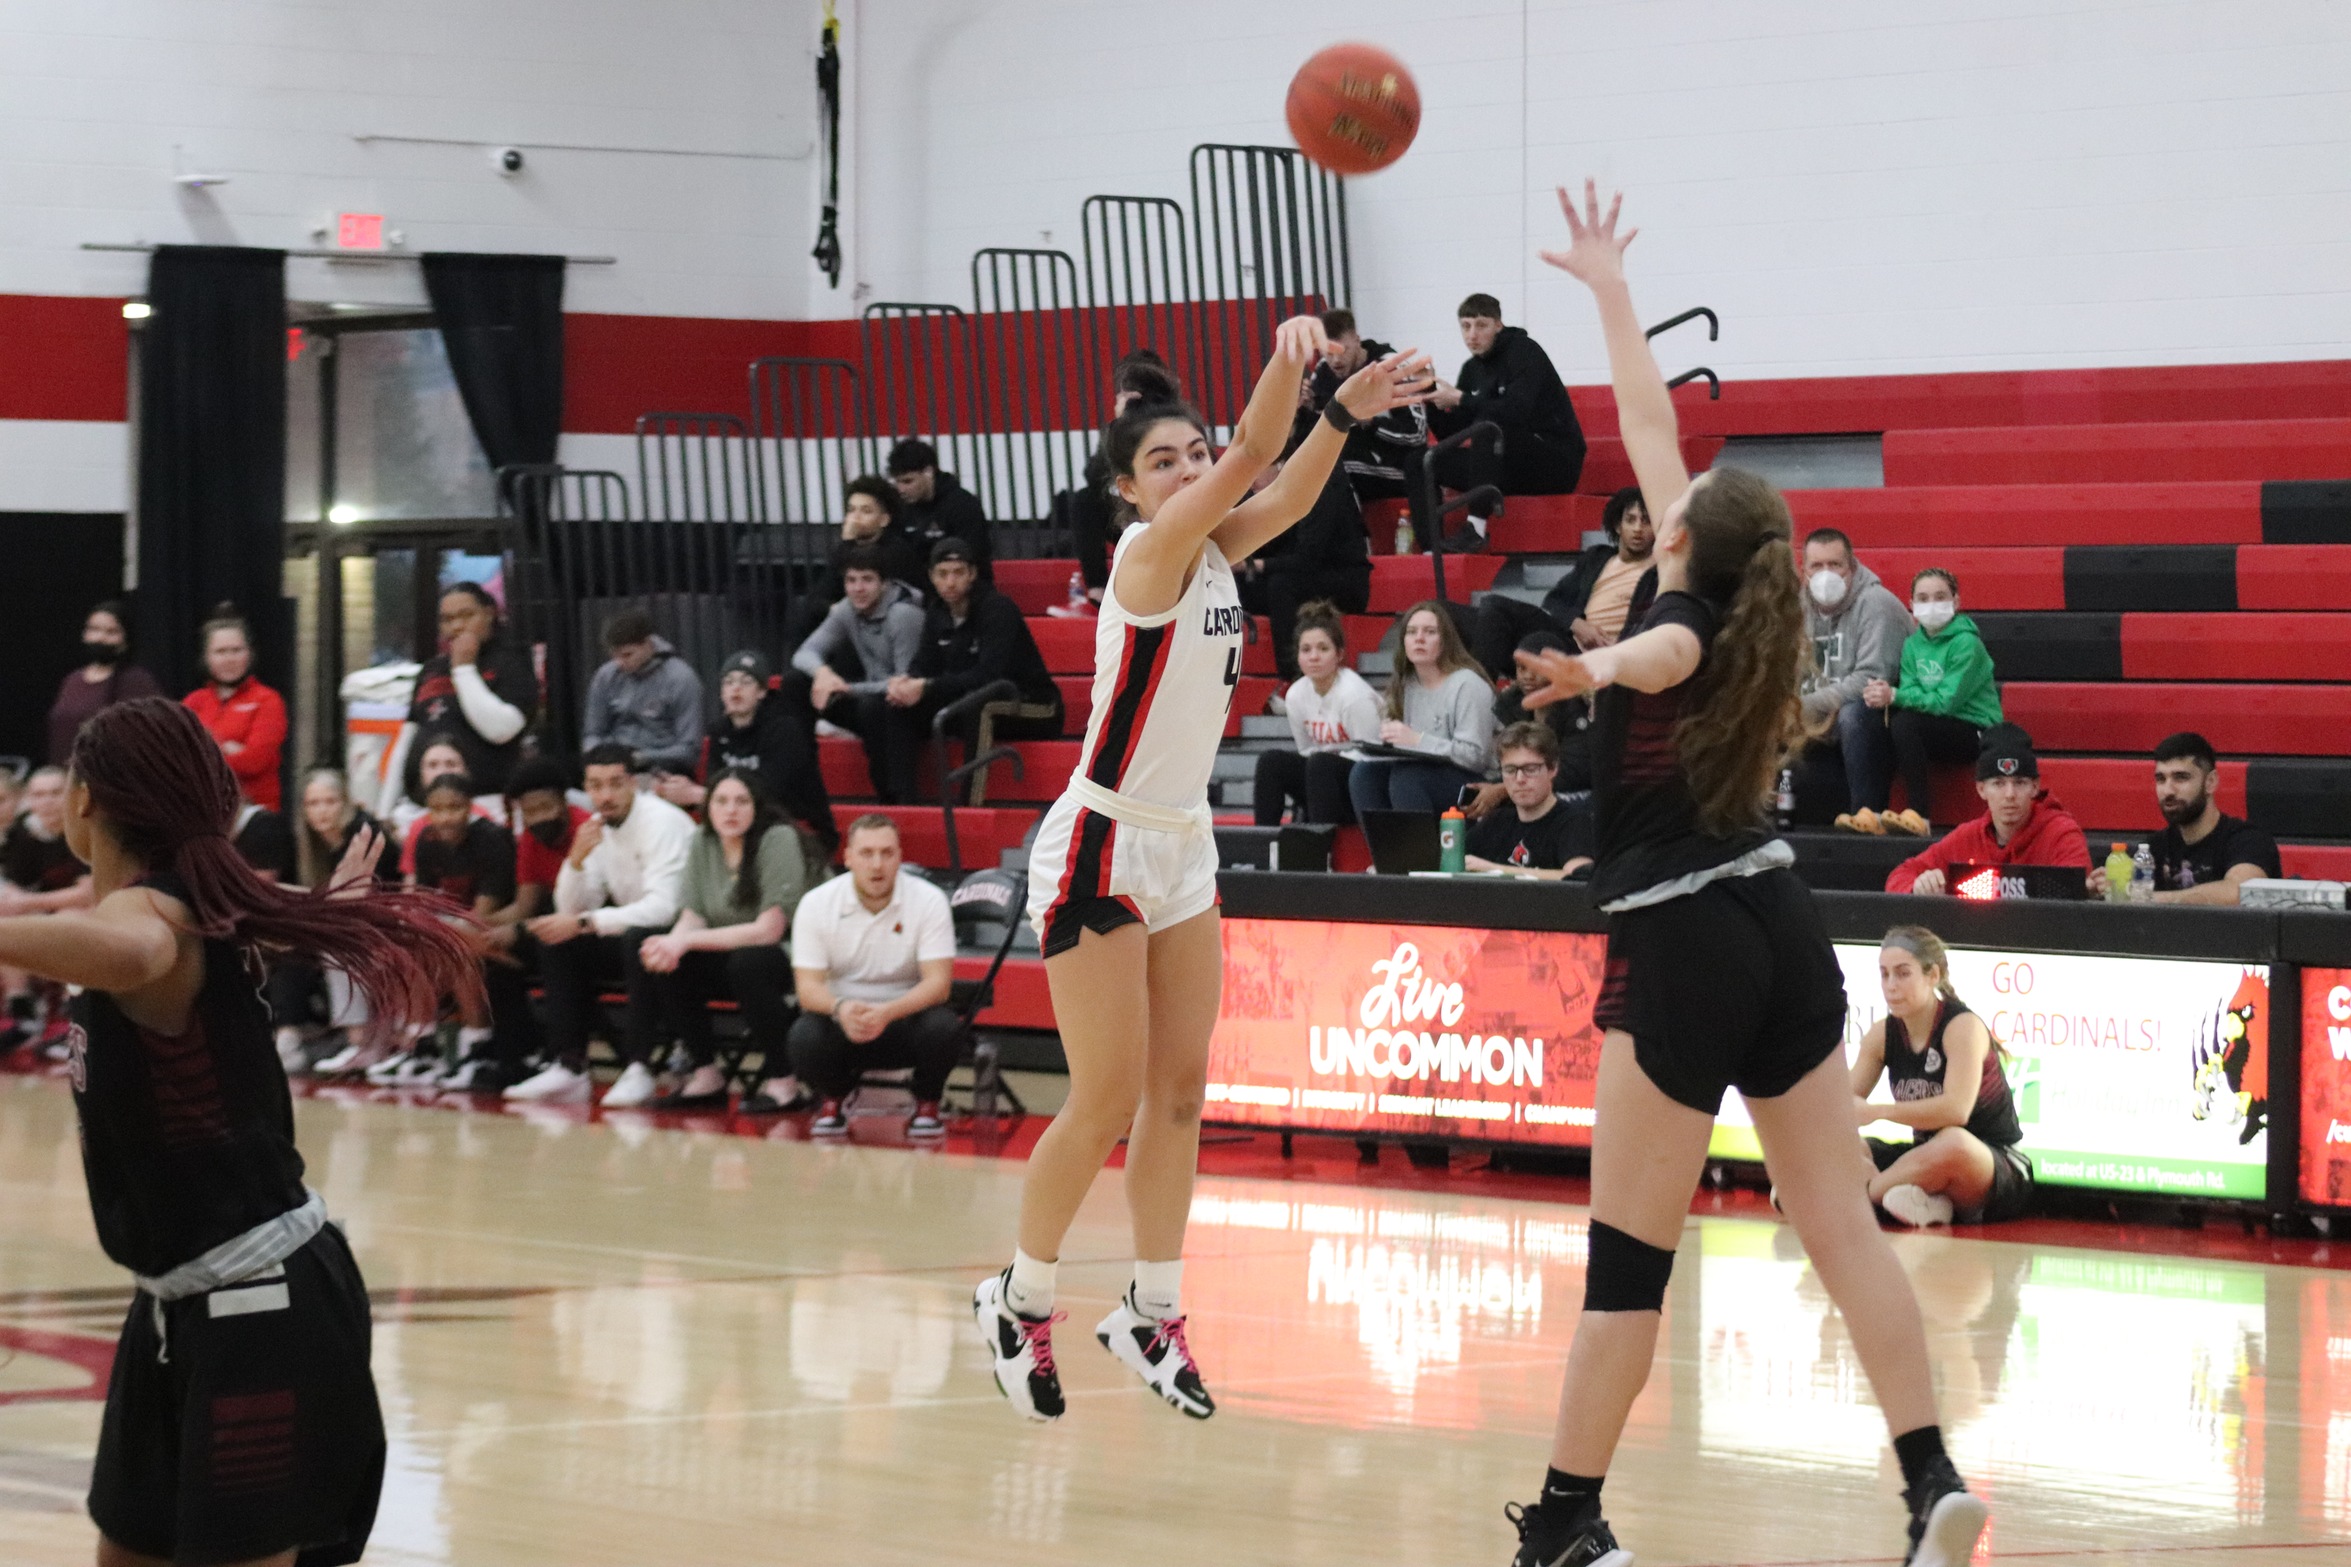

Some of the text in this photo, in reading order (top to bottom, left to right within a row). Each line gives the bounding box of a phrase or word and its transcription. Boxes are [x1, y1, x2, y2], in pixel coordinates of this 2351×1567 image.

[1360, 942, 1465, 1028] Live
[1993, 961, 2034, 994] GO
[1991, 1010, 2162, 1052] CARDINALS!
[1310, 1026, 1543, 1087] UNCOMMON
[2041, 1158, 2084, 1177] located
[2085, 1163, 2098, 1179] at
[2099, 1163, 2134, 1183] US-23
[2135, 1165, 2146, 1184] &
[2147, 1166, 2205, 1189] Plymouth
